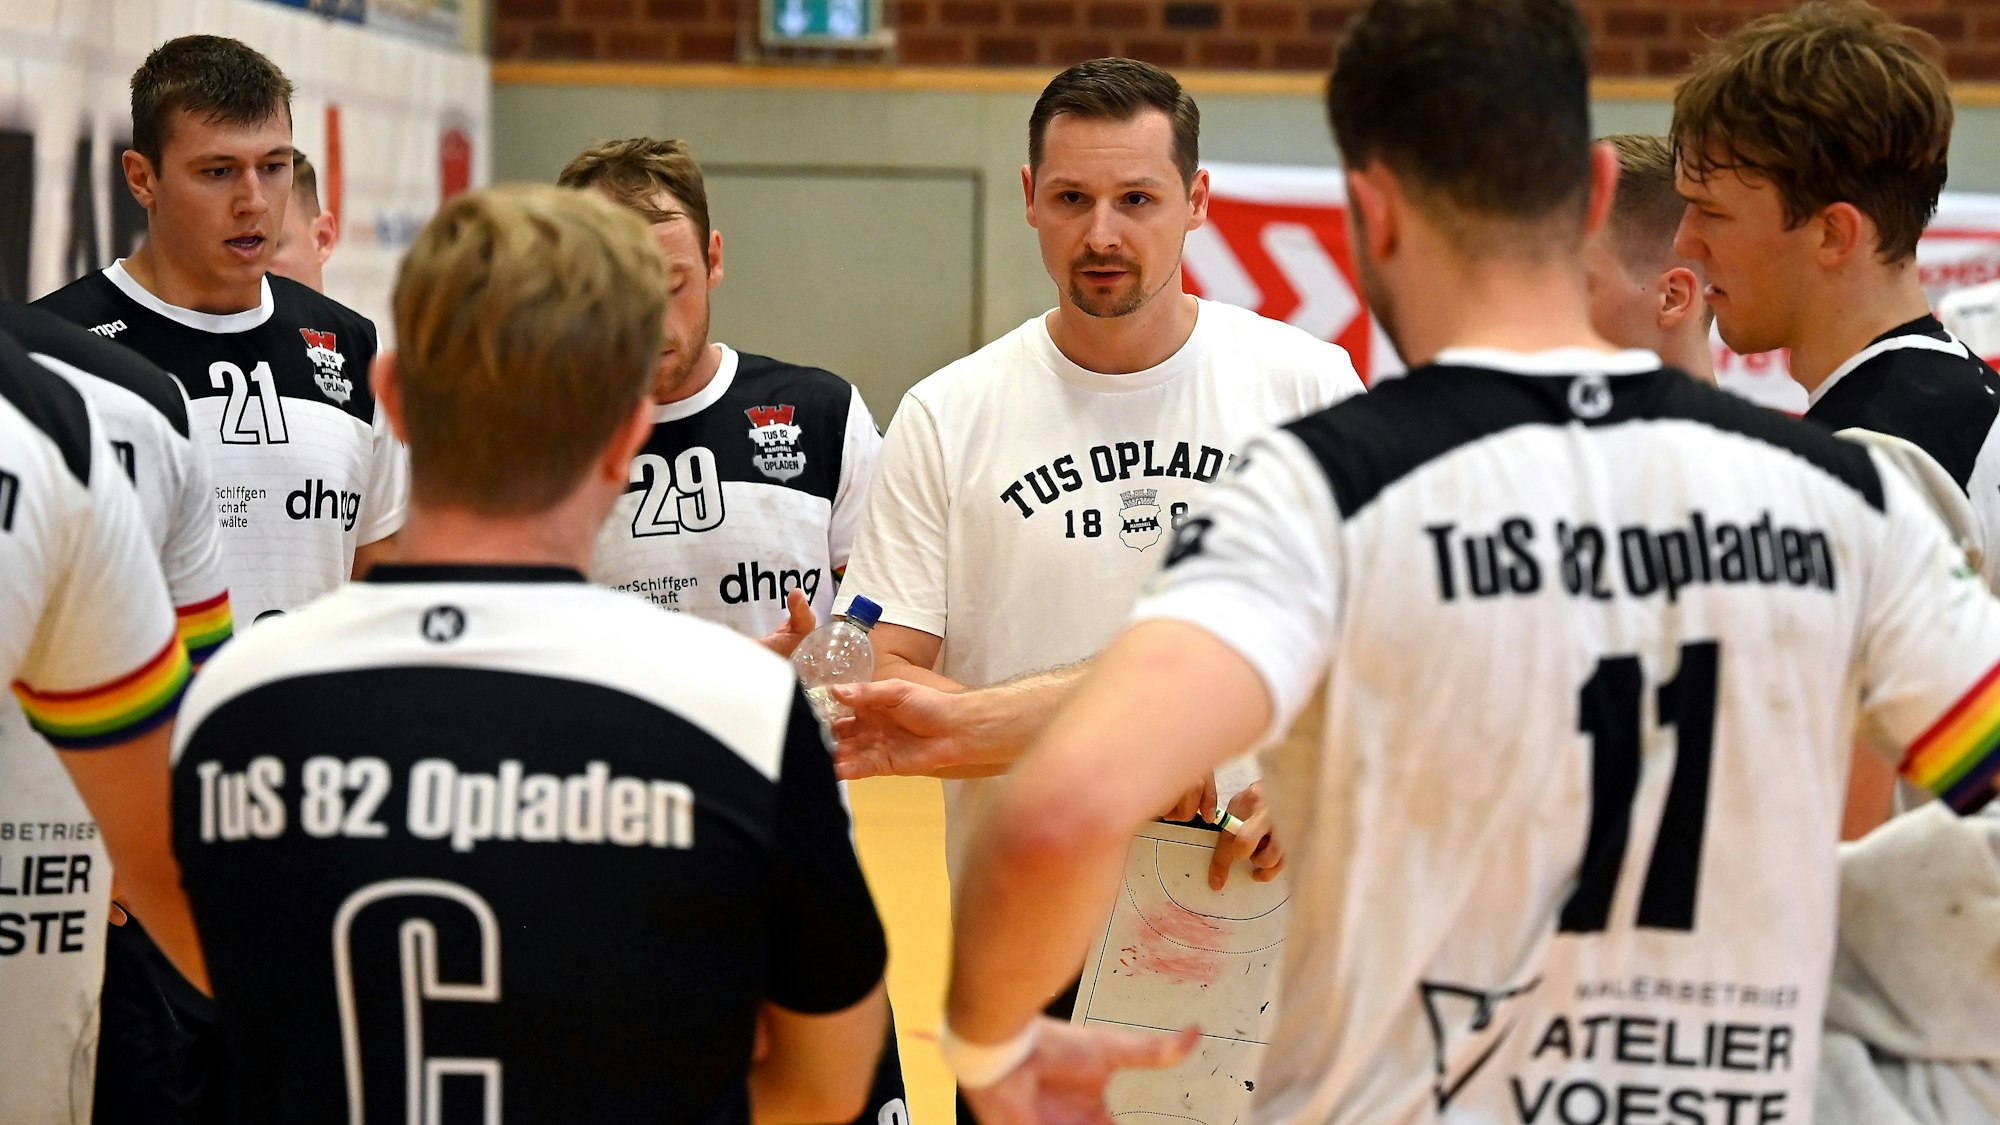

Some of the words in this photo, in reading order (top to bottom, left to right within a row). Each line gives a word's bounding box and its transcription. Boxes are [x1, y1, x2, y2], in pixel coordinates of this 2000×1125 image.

[209, 361, 289, 444] 21
[762, 430, 778, 440] TUS
[779, 429, 788, 439] 82
[629, 445, 726, 538] 29
[764, 460, 799, 471] OPLADEN
[1000, 454, 1083, 519] TUS
[1089, 439, 1238, 484] OPLAD
[720, 561, 822, 610] dhpg
[1423, 515, 1543, 603] TuS
[1618, 510, 1837, 604] Opladen
[197, 755, 287, 843] TuS
[300, 756, 392, 840] 82
[406, 758, 696, 853] Opladen
[1557, 639, 1720, 934] 11
[1531, 1012, 1795, 1072] ATELIER
